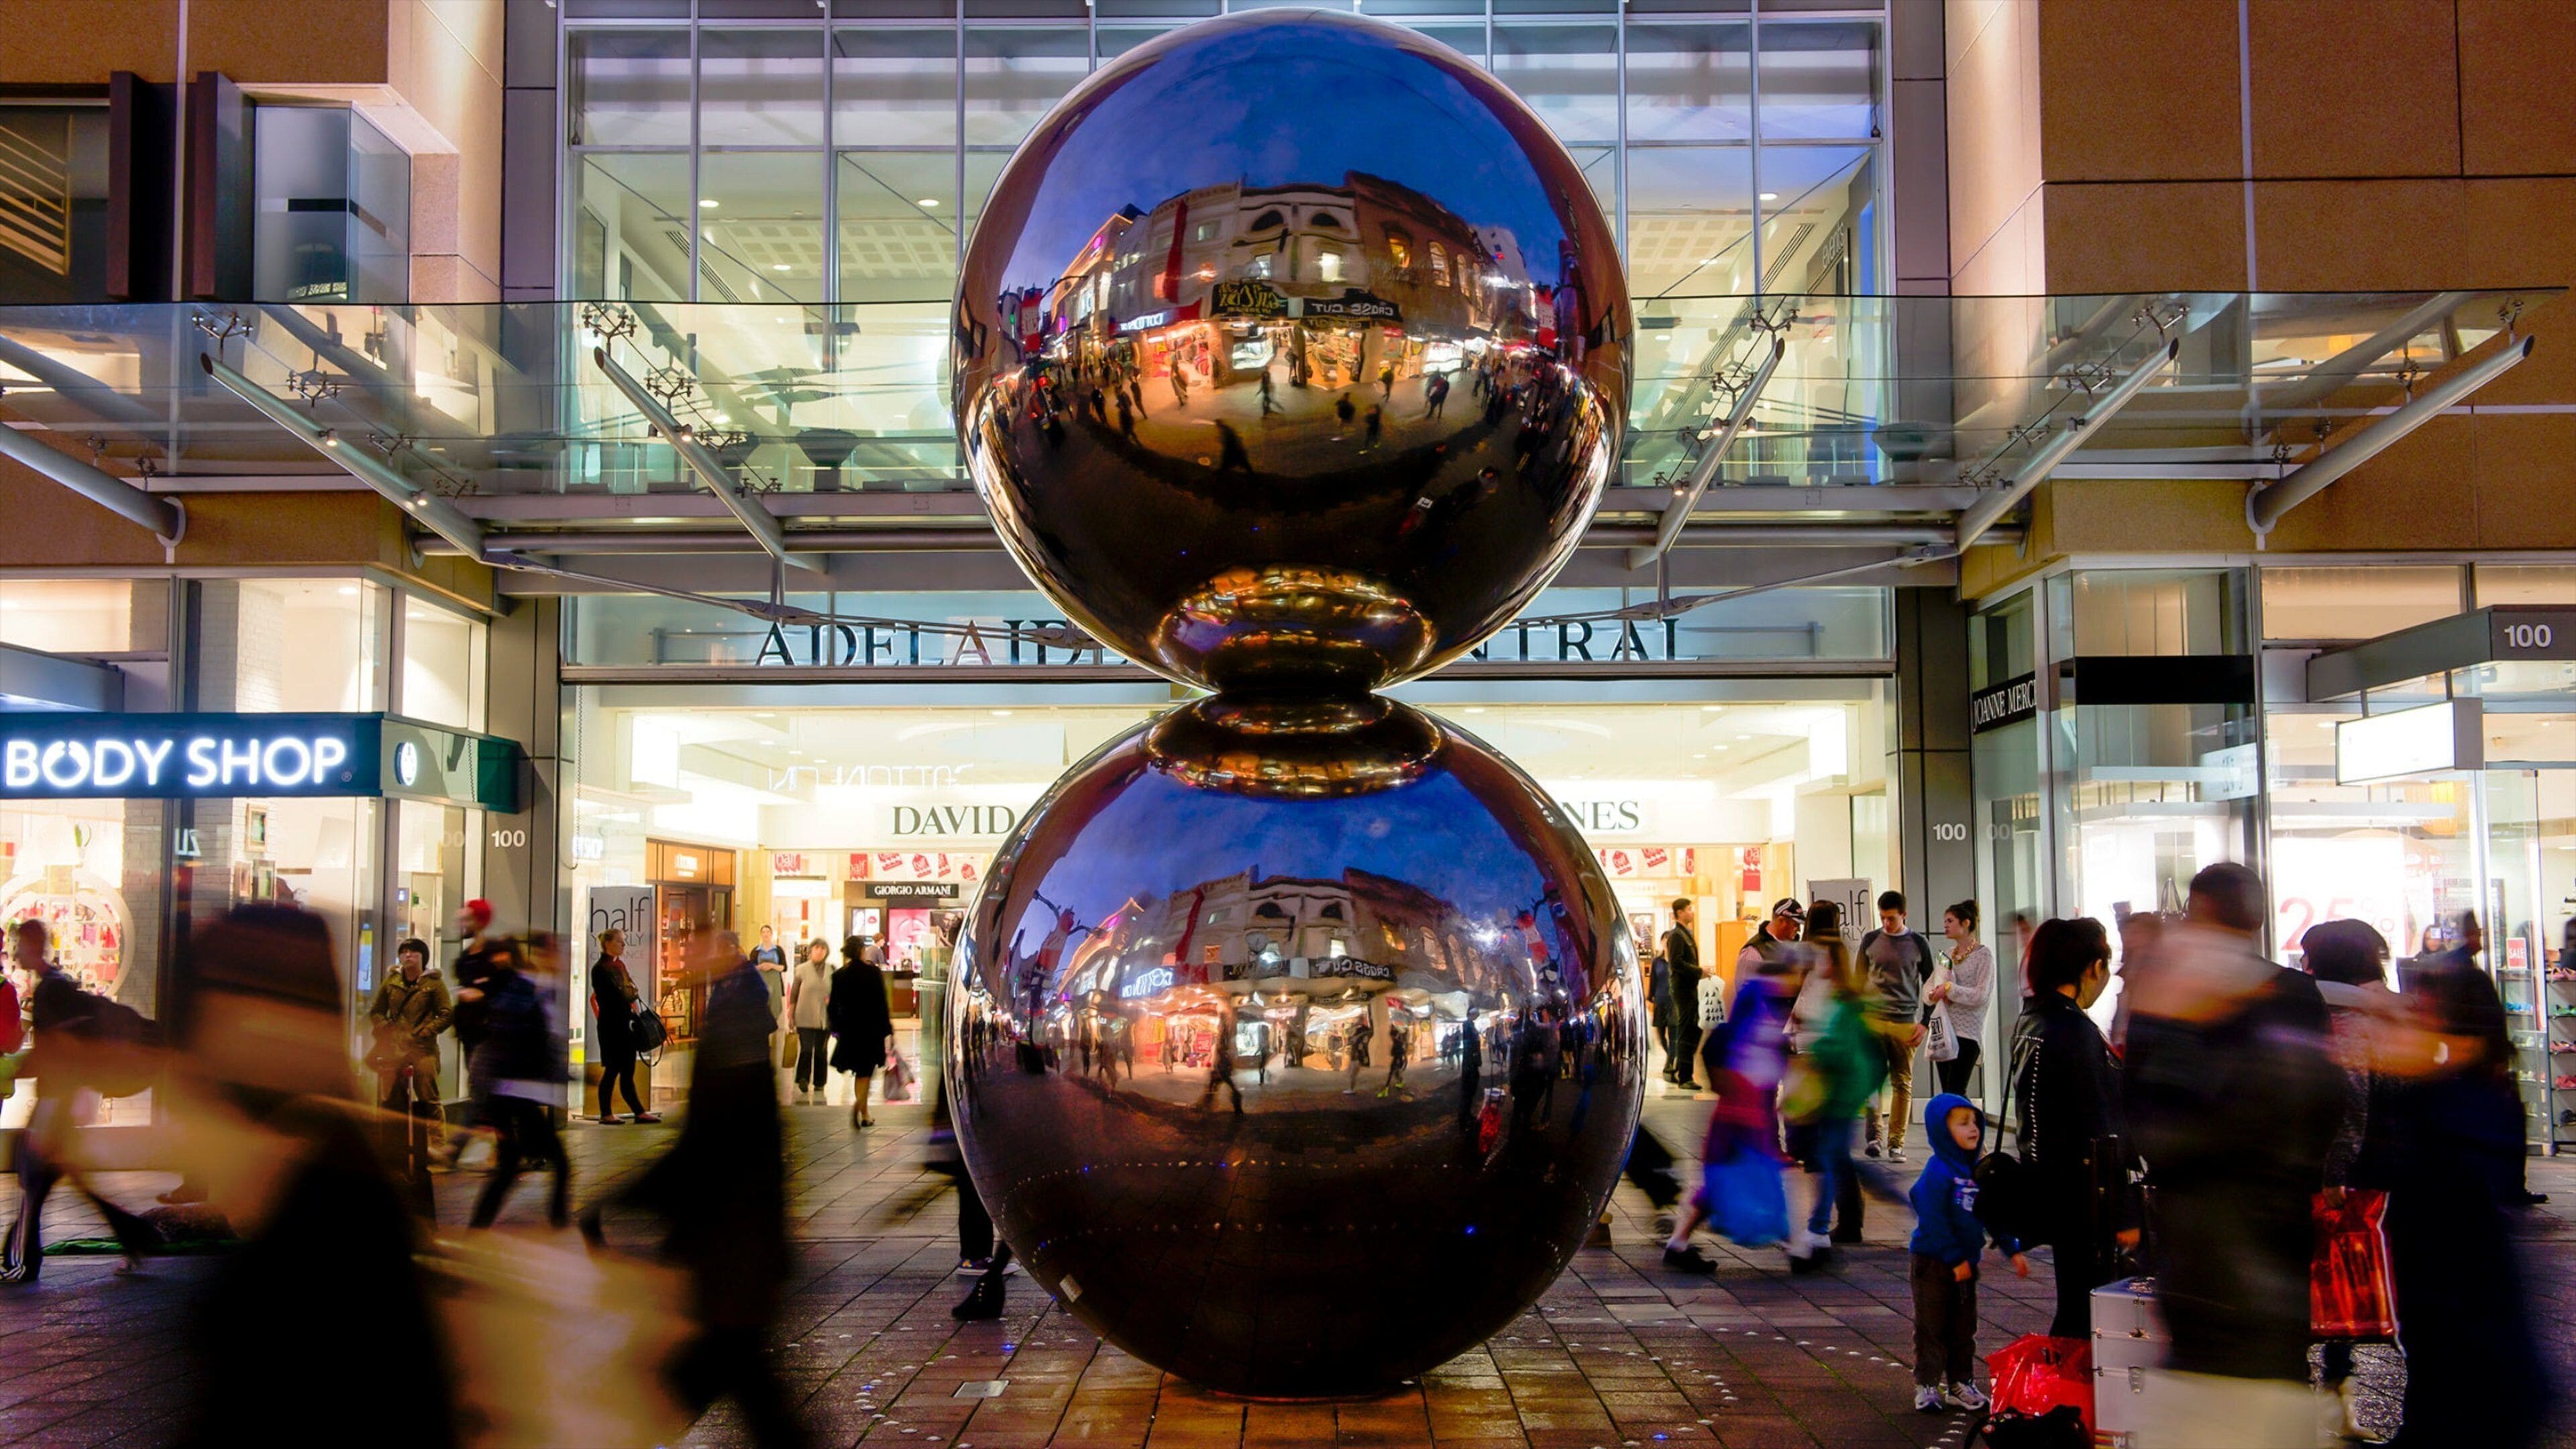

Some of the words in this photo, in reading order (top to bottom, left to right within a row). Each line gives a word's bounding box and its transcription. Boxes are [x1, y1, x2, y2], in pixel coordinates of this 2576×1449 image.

[2504, 625, 2552, 647] 100
[1974, 691, 2005, 732] JOANNE
[5, 740, 173, 787] BODY
[187, 738, 346, 786] SHOP
[892, 806, 1016, 835] DAVID
[492, 830, 526, 847] 100
[1933, 823, 1966, 841] 100
[874, 885, 913, 896] GIORGIO
[914, 885, 951, 896] ARMANI
[591, 896, 649, 933] half
[1812, 889, 1868, 926] alf
[591, 934, 645, 947] YRLY
[2509, 947, 2526, 959] SALE
